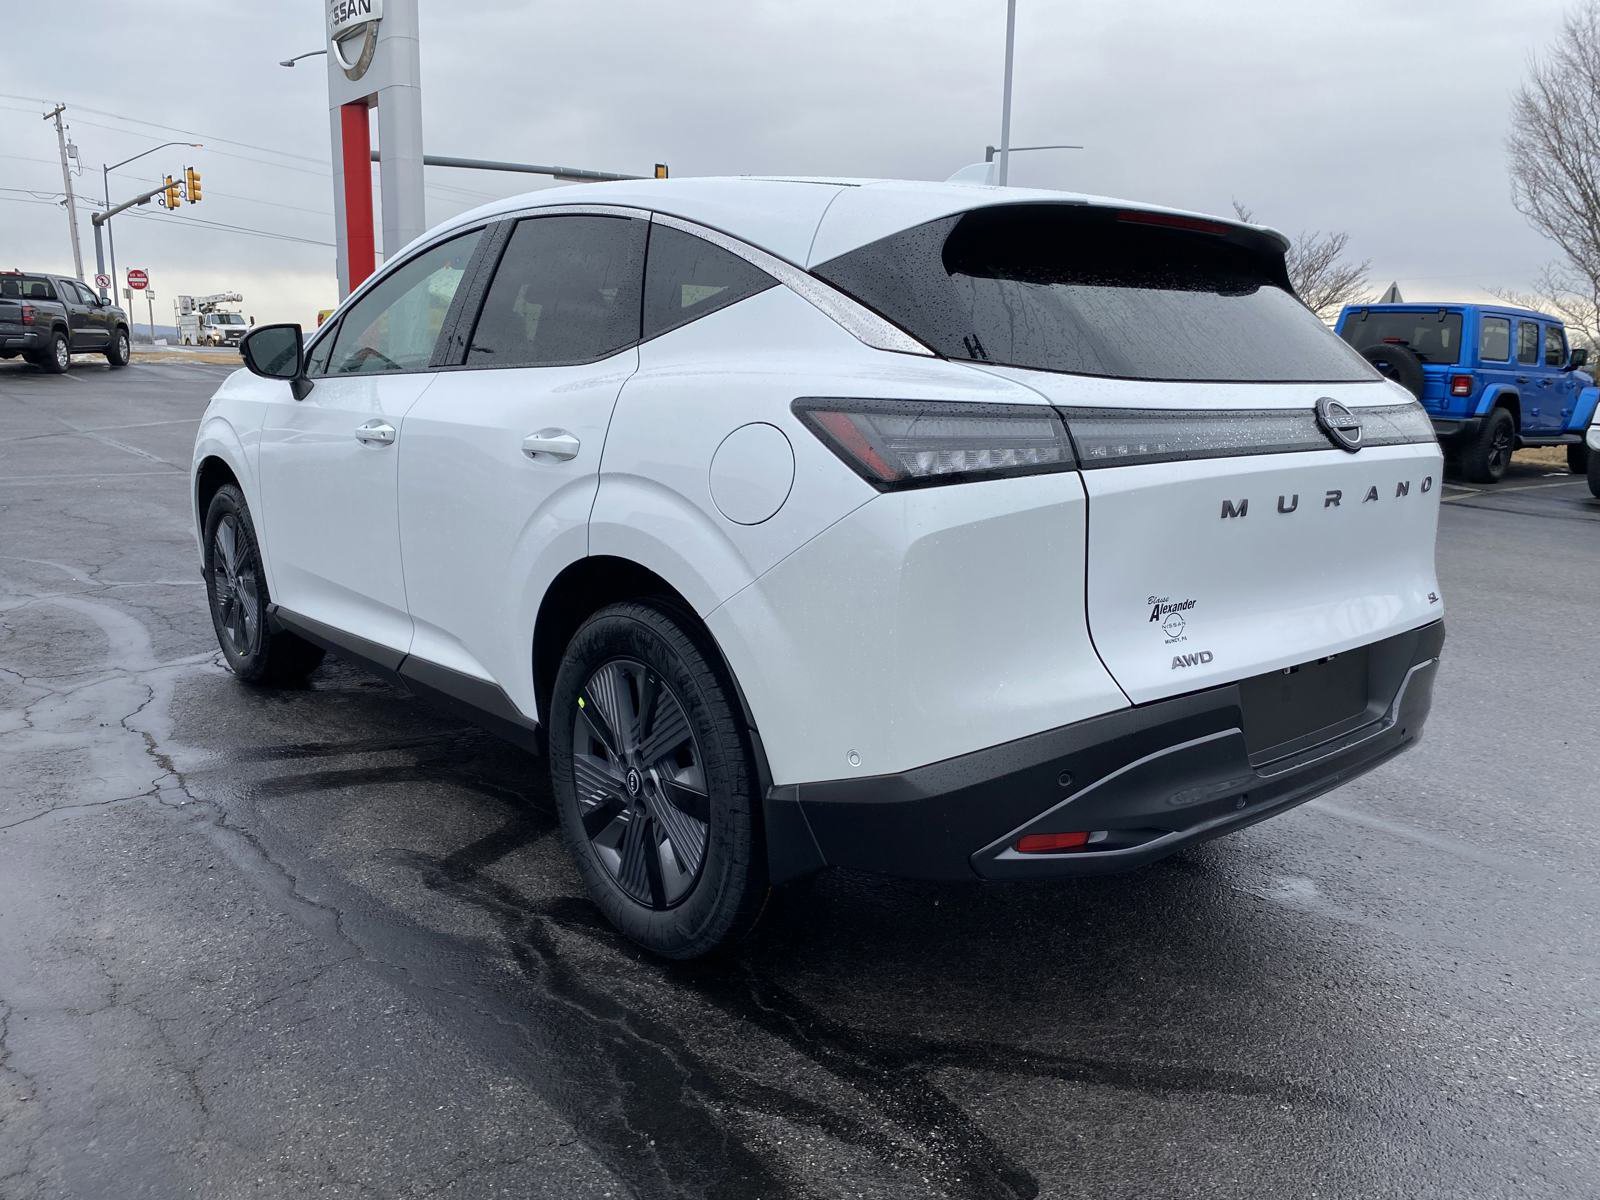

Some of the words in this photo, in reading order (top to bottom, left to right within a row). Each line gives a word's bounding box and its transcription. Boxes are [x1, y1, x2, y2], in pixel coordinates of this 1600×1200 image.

[1220, 475, 1433, 519] MURANO
[1149, 599, 1196, 622] Alexander
[1171, 650, 1214, 670] AWD
